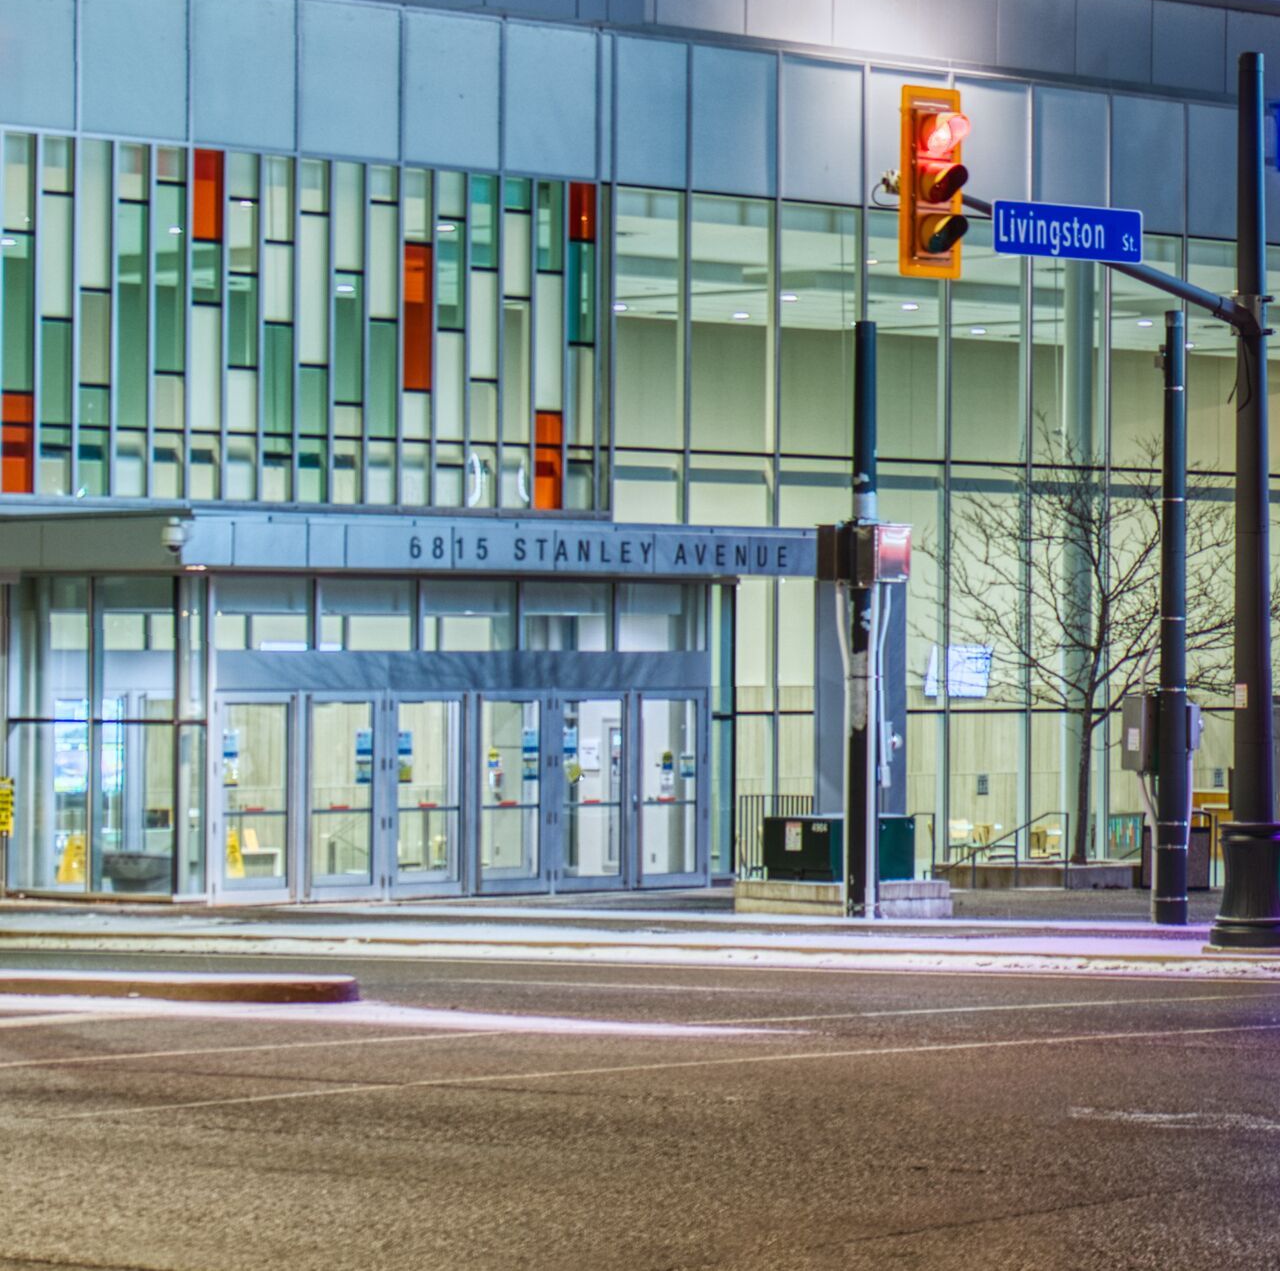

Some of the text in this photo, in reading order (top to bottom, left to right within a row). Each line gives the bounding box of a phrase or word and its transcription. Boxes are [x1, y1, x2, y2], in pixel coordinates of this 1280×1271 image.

[998, 209, 1106, 256] Livingston
[408, 536, 789, 568] 6815 STANLEY AVENUE
